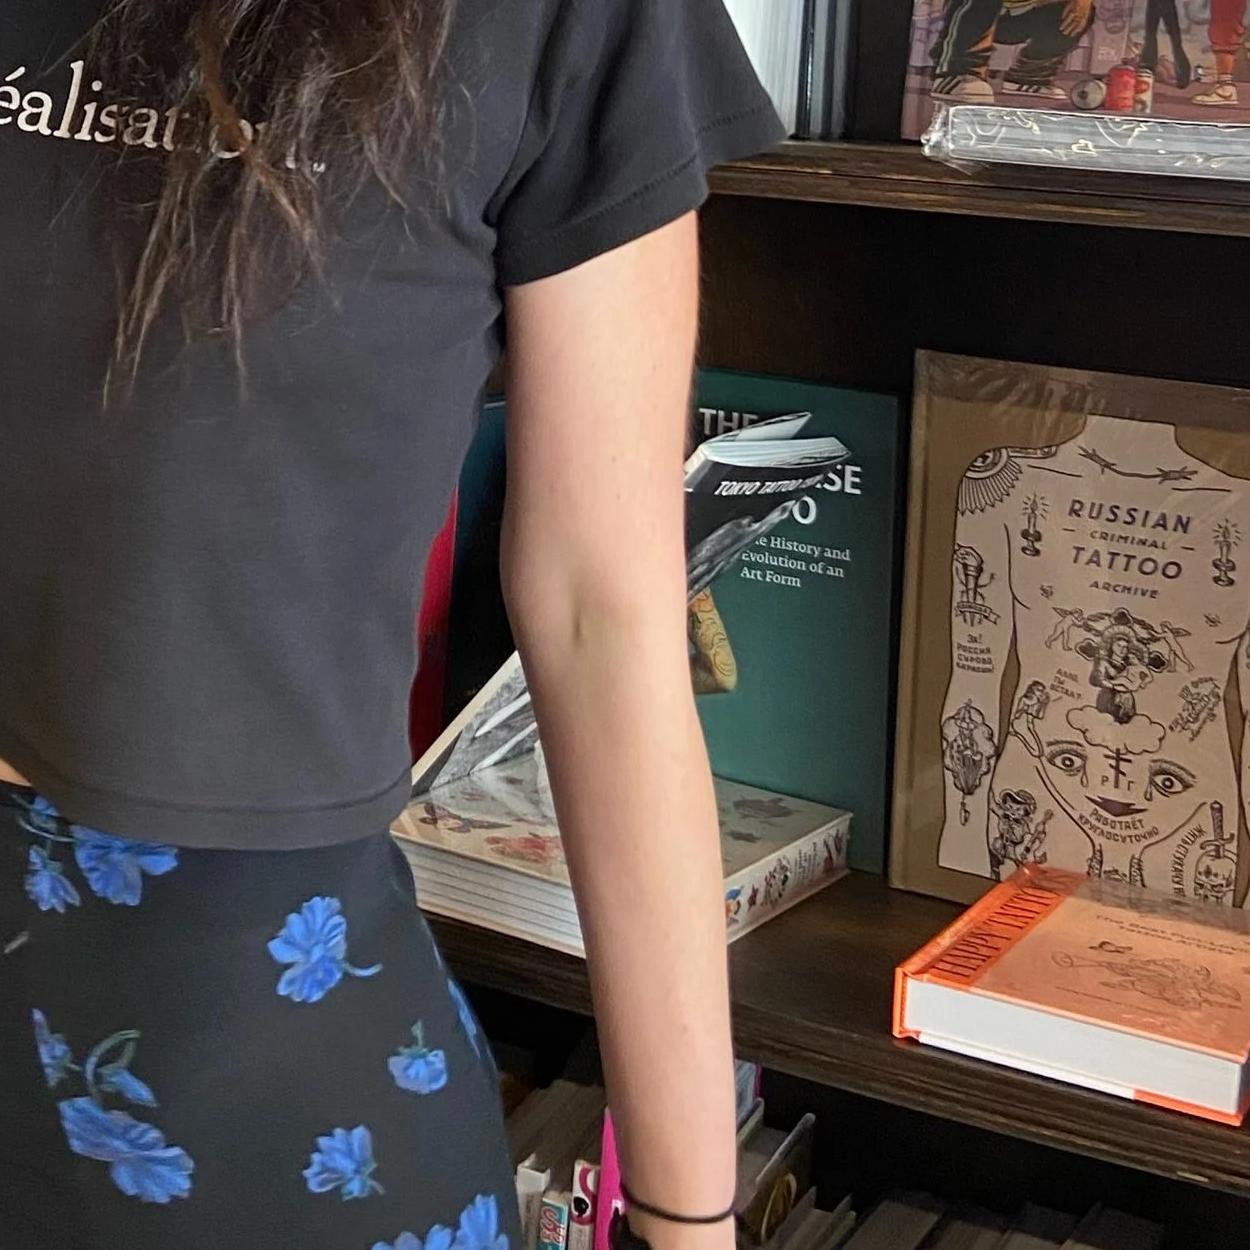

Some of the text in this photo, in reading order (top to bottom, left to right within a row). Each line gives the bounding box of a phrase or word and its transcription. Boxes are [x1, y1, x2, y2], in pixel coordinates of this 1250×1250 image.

[1067, 497, 1191, 535] RUSSIAN
[769, 535, 852, 562] History and
[1089, 529, 1169, 552] CRIMINAL
[740, 566, 802, 588] Art Form
[741, 550, 845, 579] Evolution of an
[1072, 546, 1183, 581] TATTOO
[1089, 580, 1159, 600] ARCHIVE
